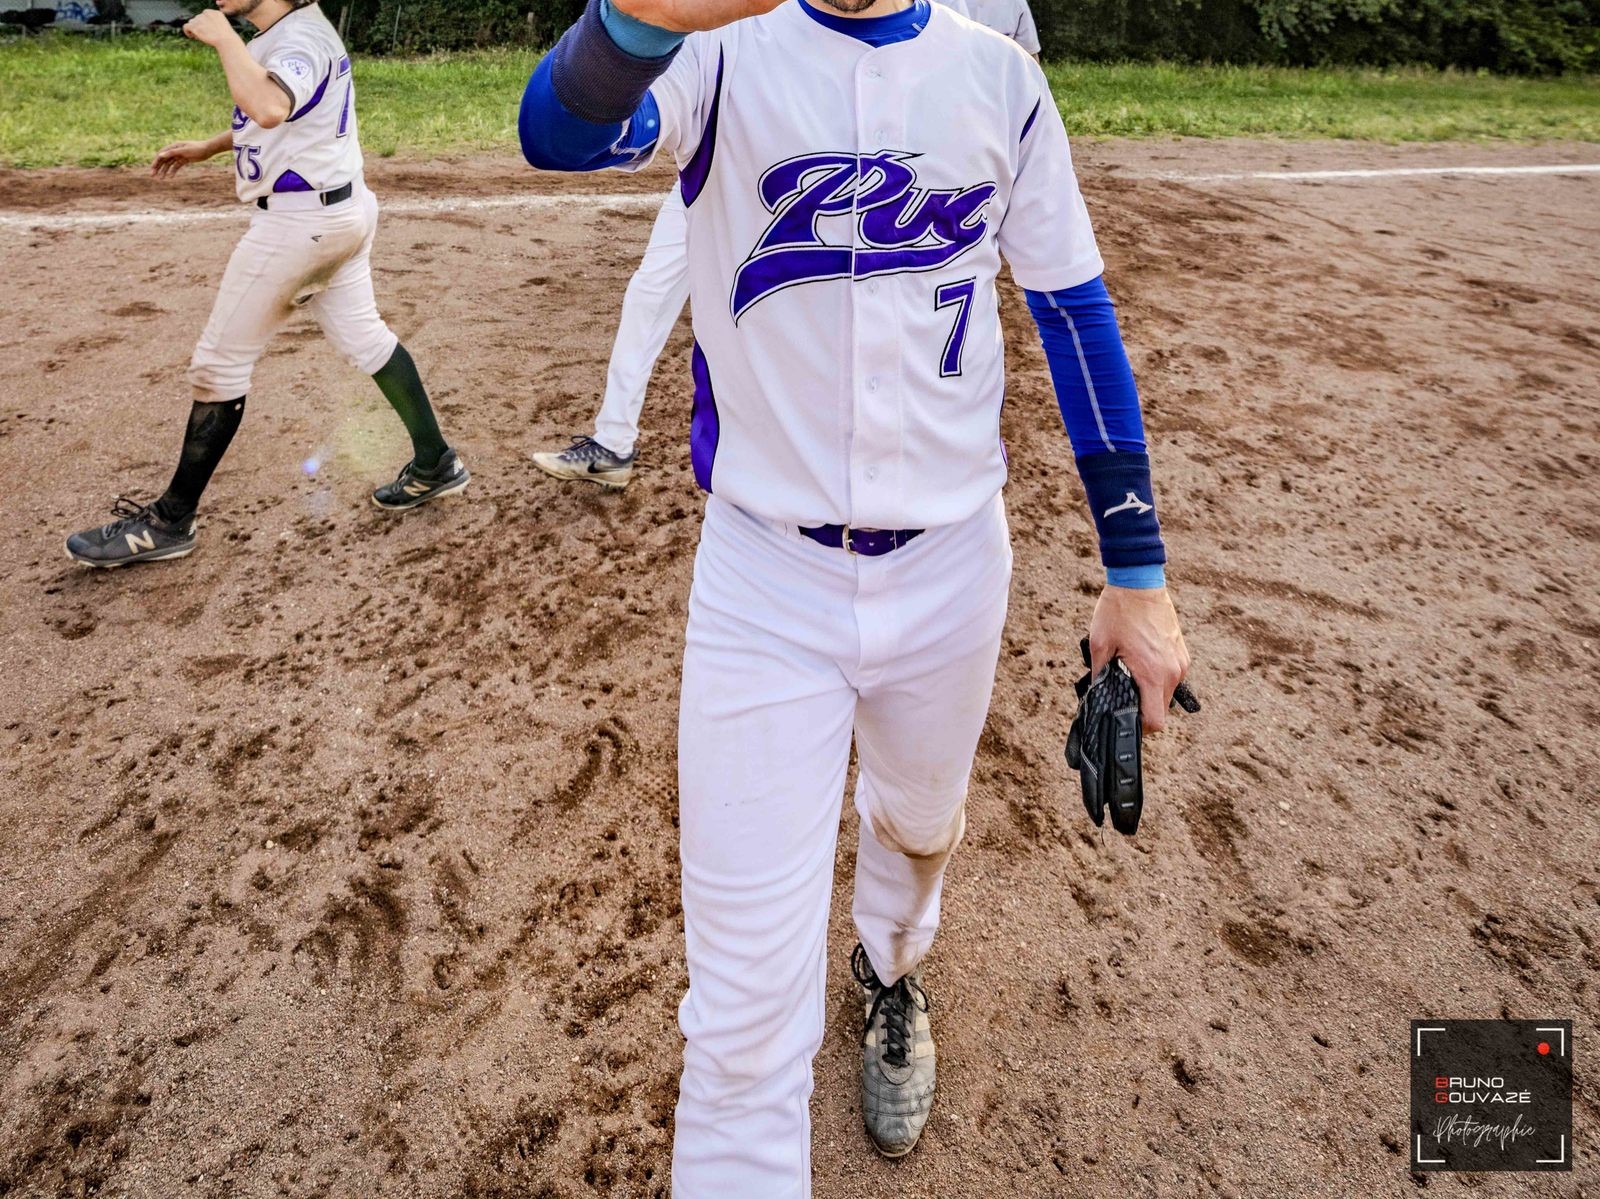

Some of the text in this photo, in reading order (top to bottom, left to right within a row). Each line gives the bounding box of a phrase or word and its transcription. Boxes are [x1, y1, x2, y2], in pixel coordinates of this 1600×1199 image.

[232, 143, 263, 183] 75
[935, 276, 977, 378] 7
[125, 530, 156, 554] N
